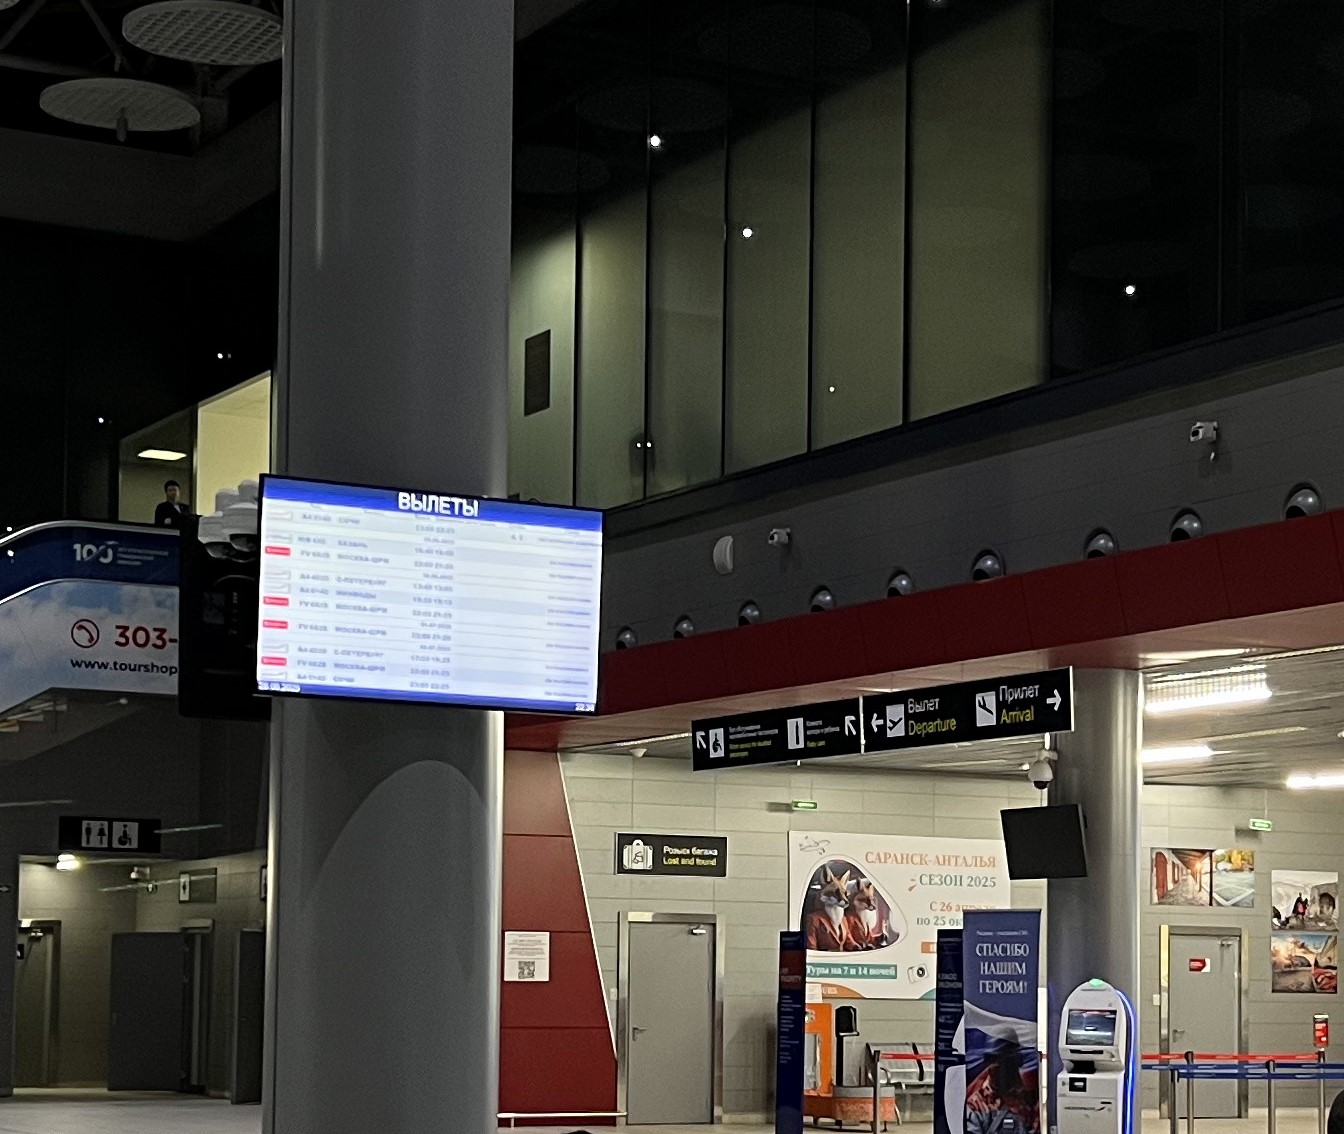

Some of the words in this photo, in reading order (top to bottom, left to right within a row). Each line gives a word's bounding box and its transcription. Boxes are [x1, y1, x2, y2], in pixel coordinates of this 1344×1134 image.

[397, 491, 479, 517] ВЫЛЕТЫ
[114, 625, 178, 650] 303-
[70, 659, 178, 676] www.tourshop
[908, 698, 940, 713] Вылет
[1000, 684, 1040, 704] Прилет
[908, 717, 956, 737] Departure
[1000, 706, 1034, 724] Arrival
[663, 856, 679, 865] Lost
[680, 857, 695, 865] and
[695, 858, 717, 866] found
[865, 851, 996, 868] САРАНСК-АНТАЛЬЯ
[919, 873, 963, 887] СЕЗОН
[966, 875, 996, 888] 2025
[939, 901, 953, 912] 26
[916, 917, 930, 926] по
[933, 915, 946, 926] 25
[948, 917, 963, 926] ок
[976, 943, 1030, 957] СПАСИБО
[843, 966, 850, 975] 7
[857, 966, 868, 975] 14
[980, 961, 1026, 975] НАШИМ
[979, 980, 1027, 994] ГЕРОЯМ!
